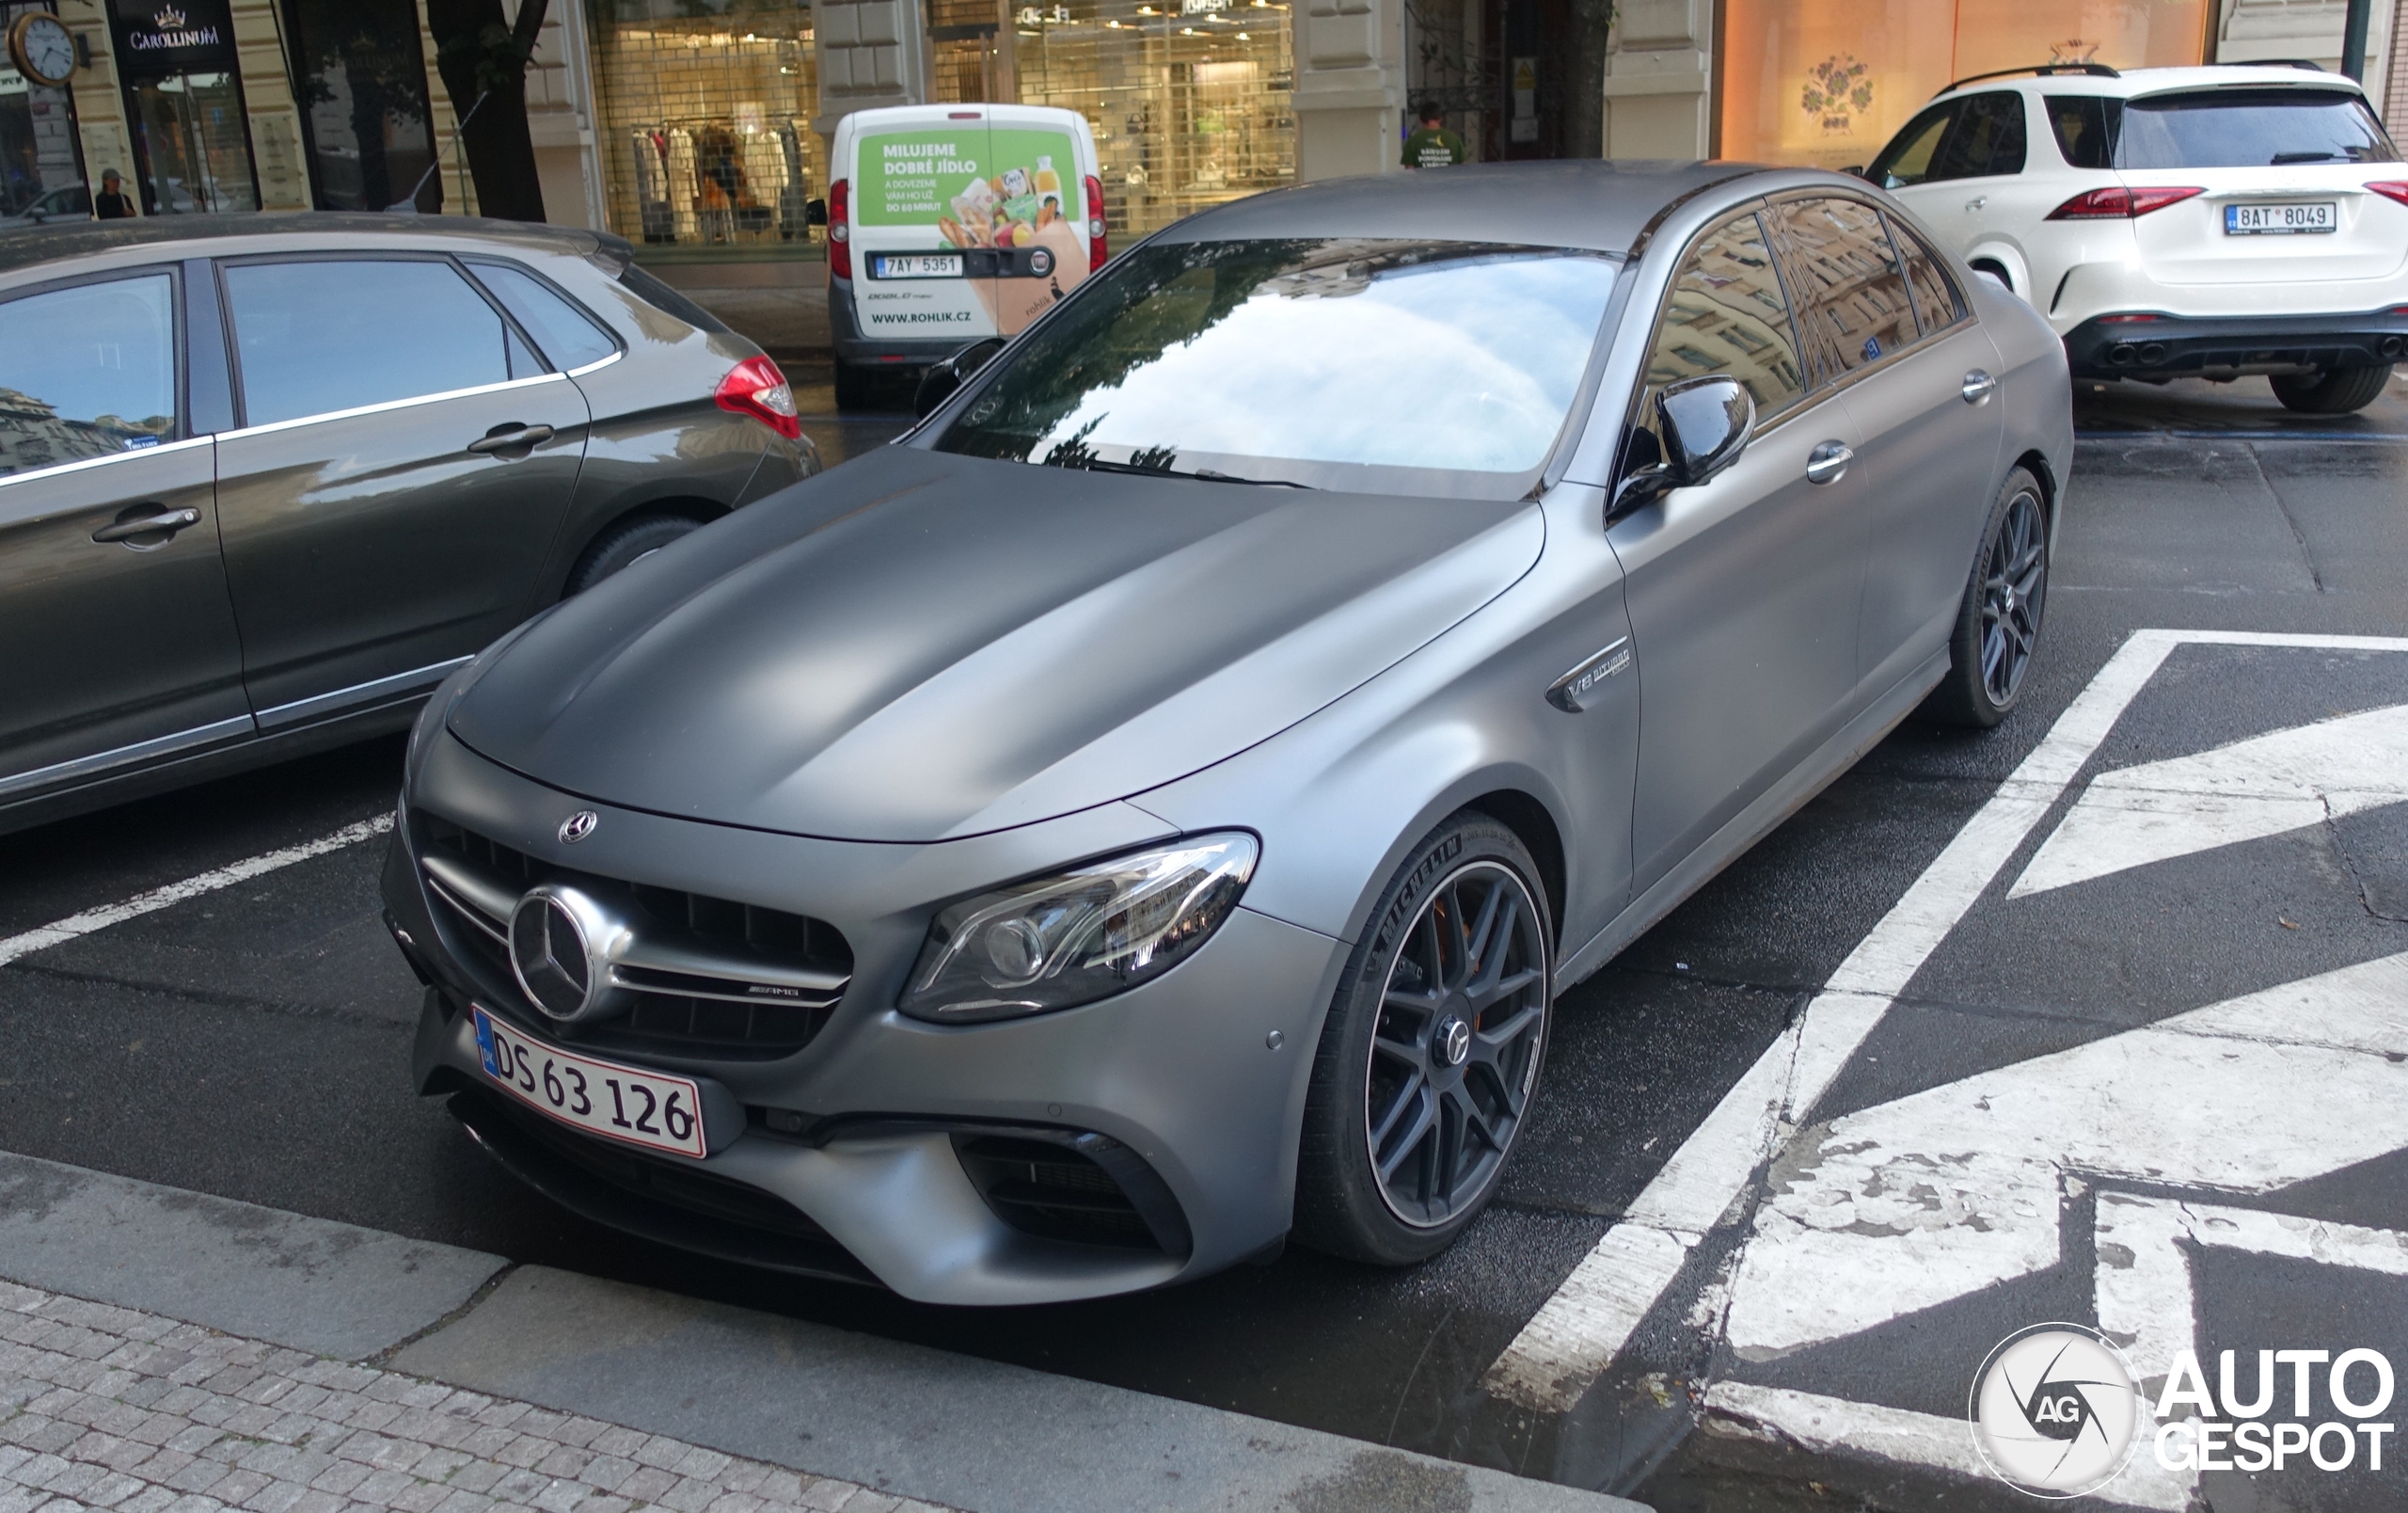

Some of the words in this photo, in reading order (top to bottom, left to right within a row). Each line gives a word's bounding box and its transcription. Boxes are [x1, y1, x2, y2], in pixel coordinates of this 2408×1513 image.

[130, 26, 219, 50] CAROLLINUM
[883, 143, 957, 158] MILUJEME
[884, 158, 933, 175] DOBRÉ
[936, 158, 977, 174] JÍDLO
[885, 181, 892, 189] A
[893, 179, 937, 189] DOVEZEME
[886, 191, 905, 200] VÁM
[907, 191, 921, 199] HO
[922, 190, 934, 199] UŽ
[886, 203, 900, 213] DO
[901, 203, 912, 213] 60
[913, 202, 942, 212] MINUT
[2242, 208, 2271, 227] 8AT
[2285, 207, 2326, 225] 8049
[888, 258, 912, 273] 7AY
[923, 257, 955, 271] 5351
[1025, 295, 1052, 316] rohlik
[872, 311, 972, 324] WWW.ROHLIK.CZ
[1568, 673, 1592, 698] V8
[1593, 648, 1630, 683] BITURBO
[1380, 835, 1462, 944] MICHELIN
[761, 987, 800, 996] AMG
[483, 1049, 495, 1065] DK
[494, 1030, 536, 1092] DS
[544, 1059, 592, 1116] 63
[606, 1078, 695, 1140] 126
